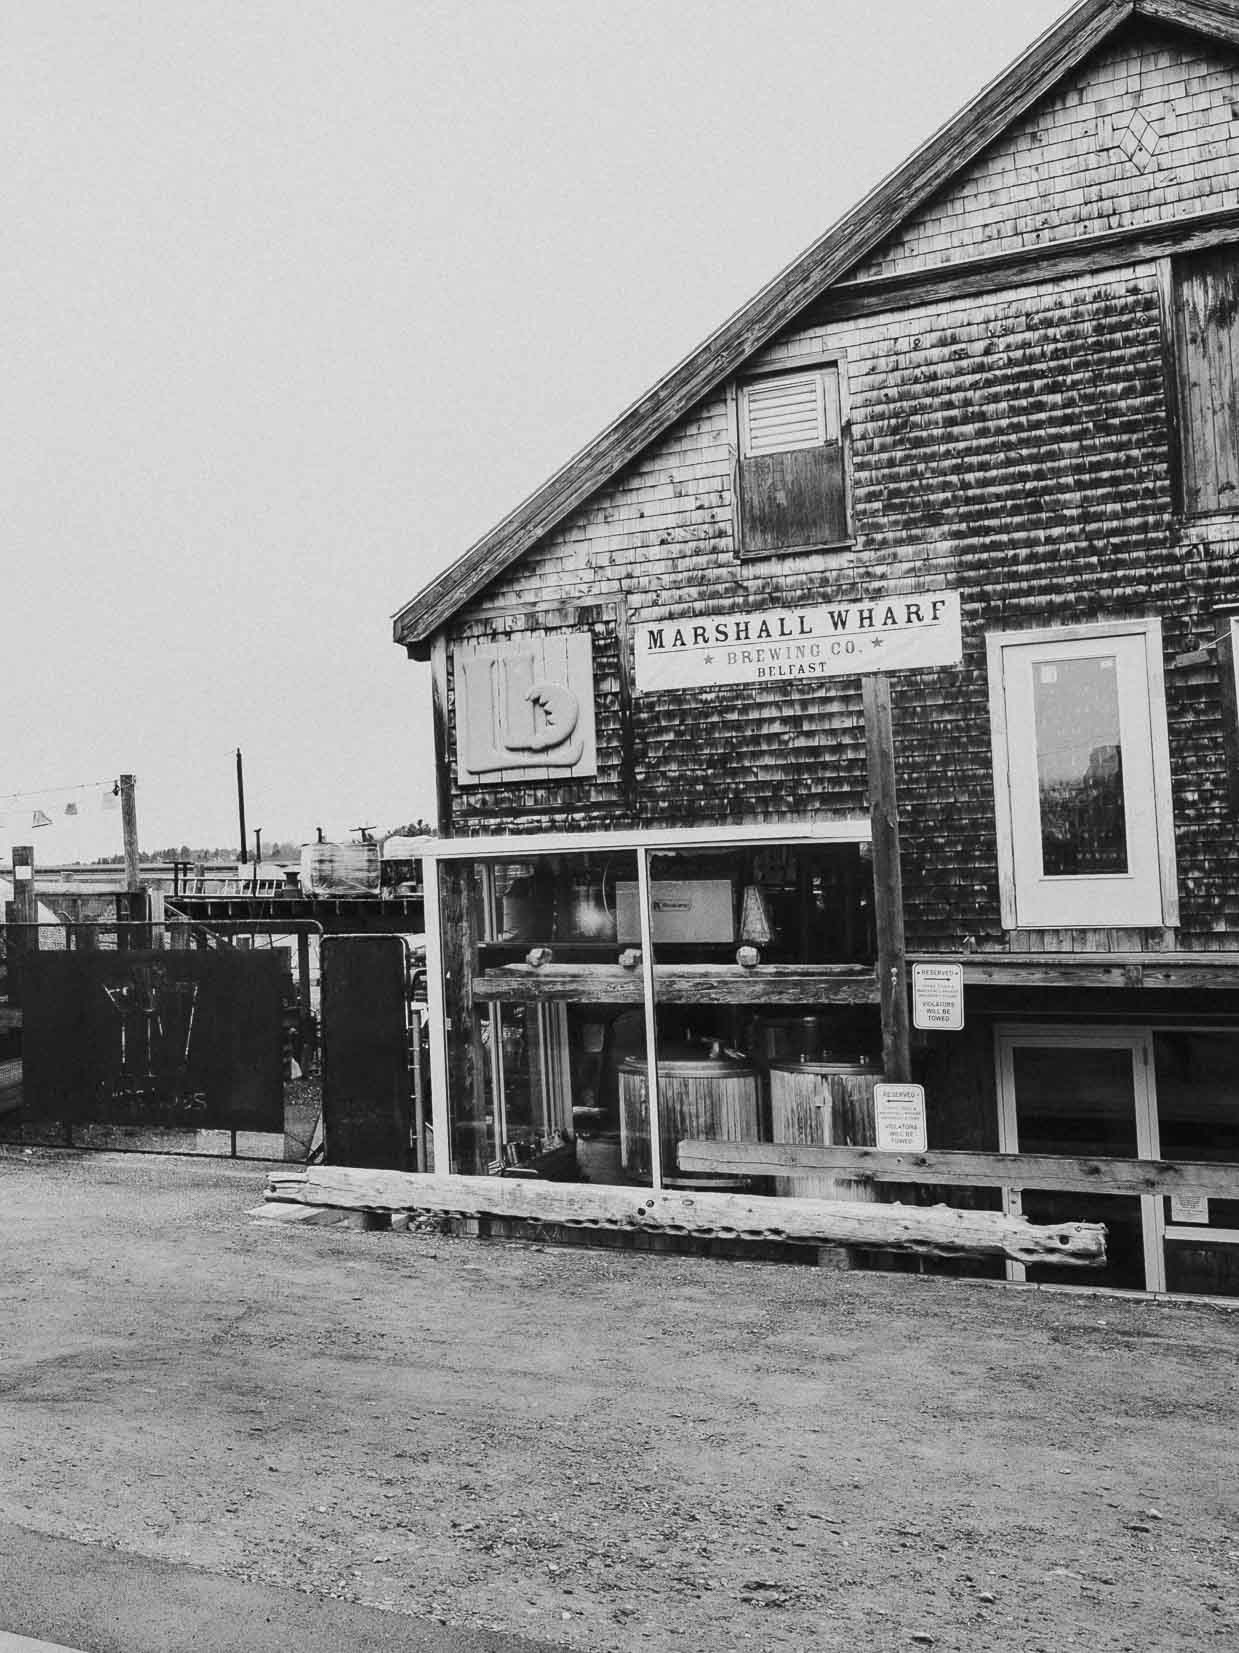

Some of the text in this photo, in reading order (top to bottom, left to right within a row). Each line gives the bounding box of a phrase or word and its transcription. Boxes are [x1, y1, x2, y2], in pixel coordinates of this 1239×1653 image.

[647, 600, 947, 650] MARSHALL WHARF
[727, 640, 863, 665] BREWING CO.
[757, 661, 827, 678] BELFAST
